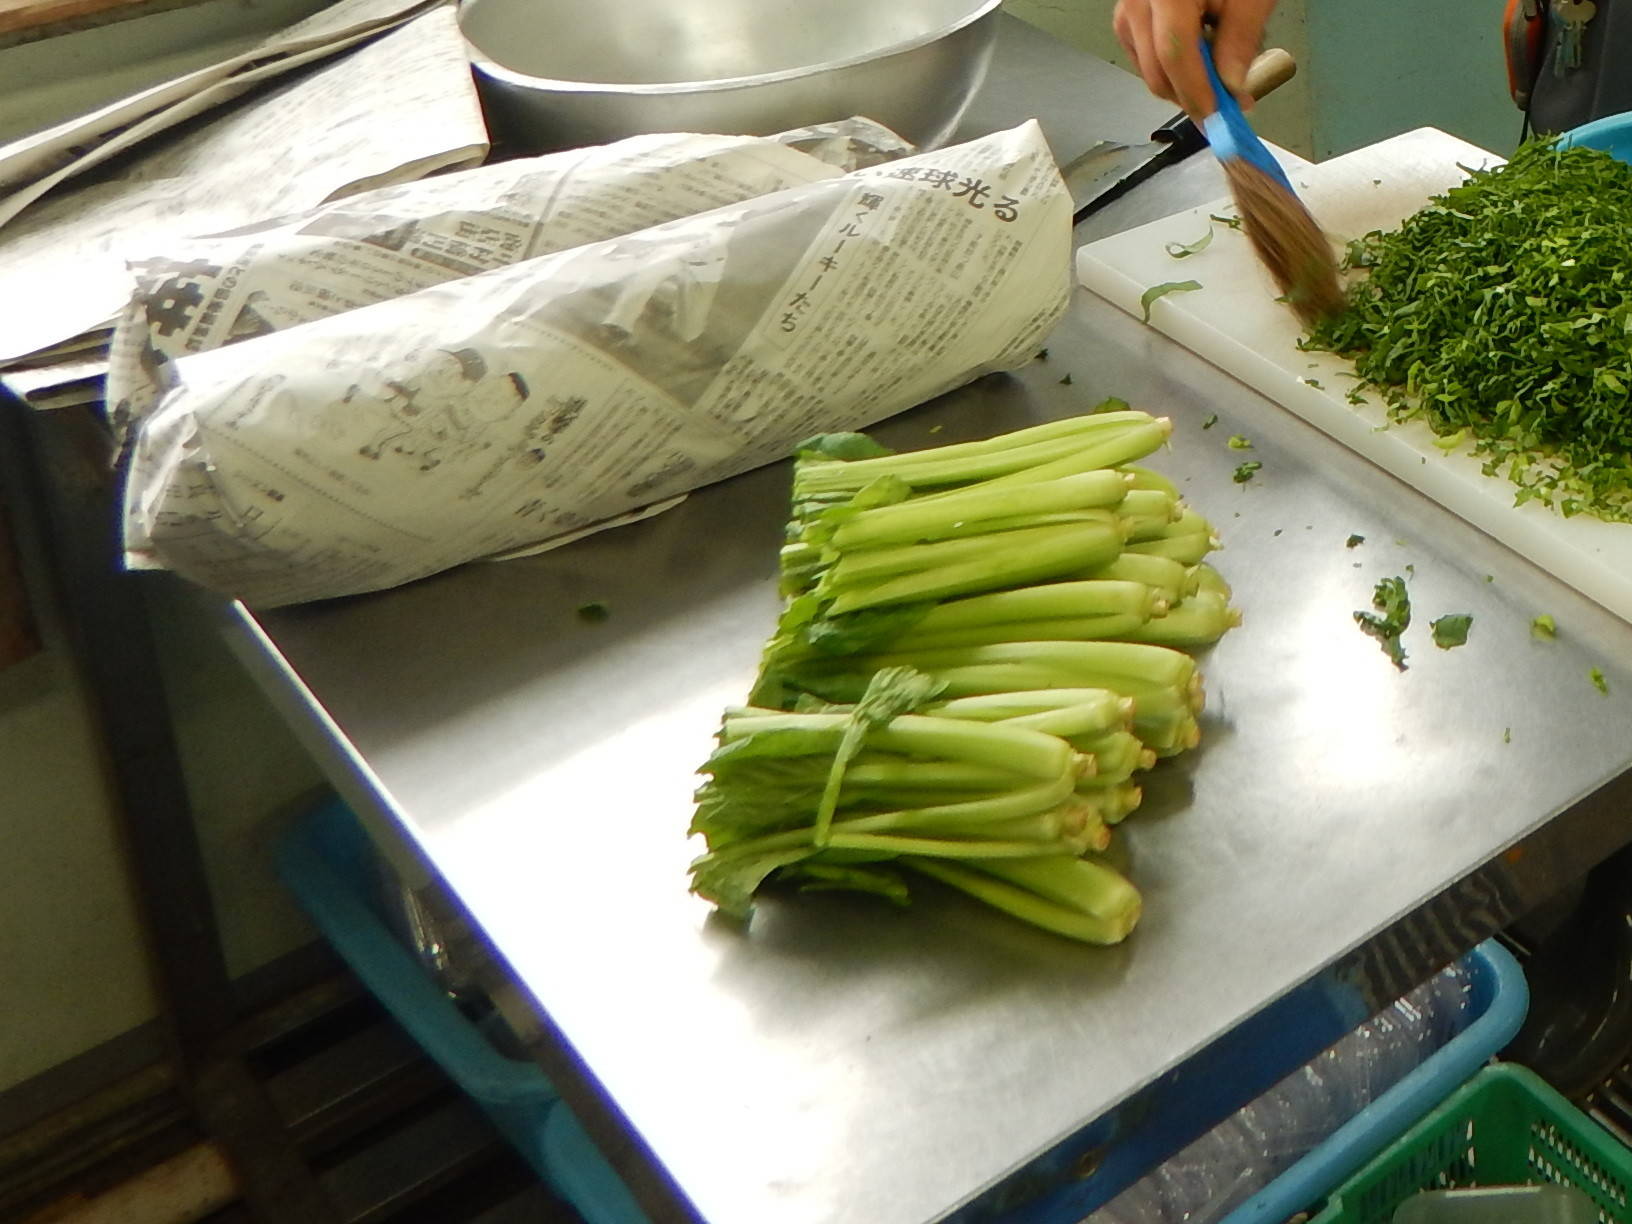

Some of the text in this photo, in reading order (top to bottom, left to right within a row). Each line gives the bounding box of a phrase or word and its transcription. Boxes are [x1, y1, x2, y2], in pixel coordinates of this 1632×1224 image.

[780, 191, 885, 334] 輝くルーキーたち
